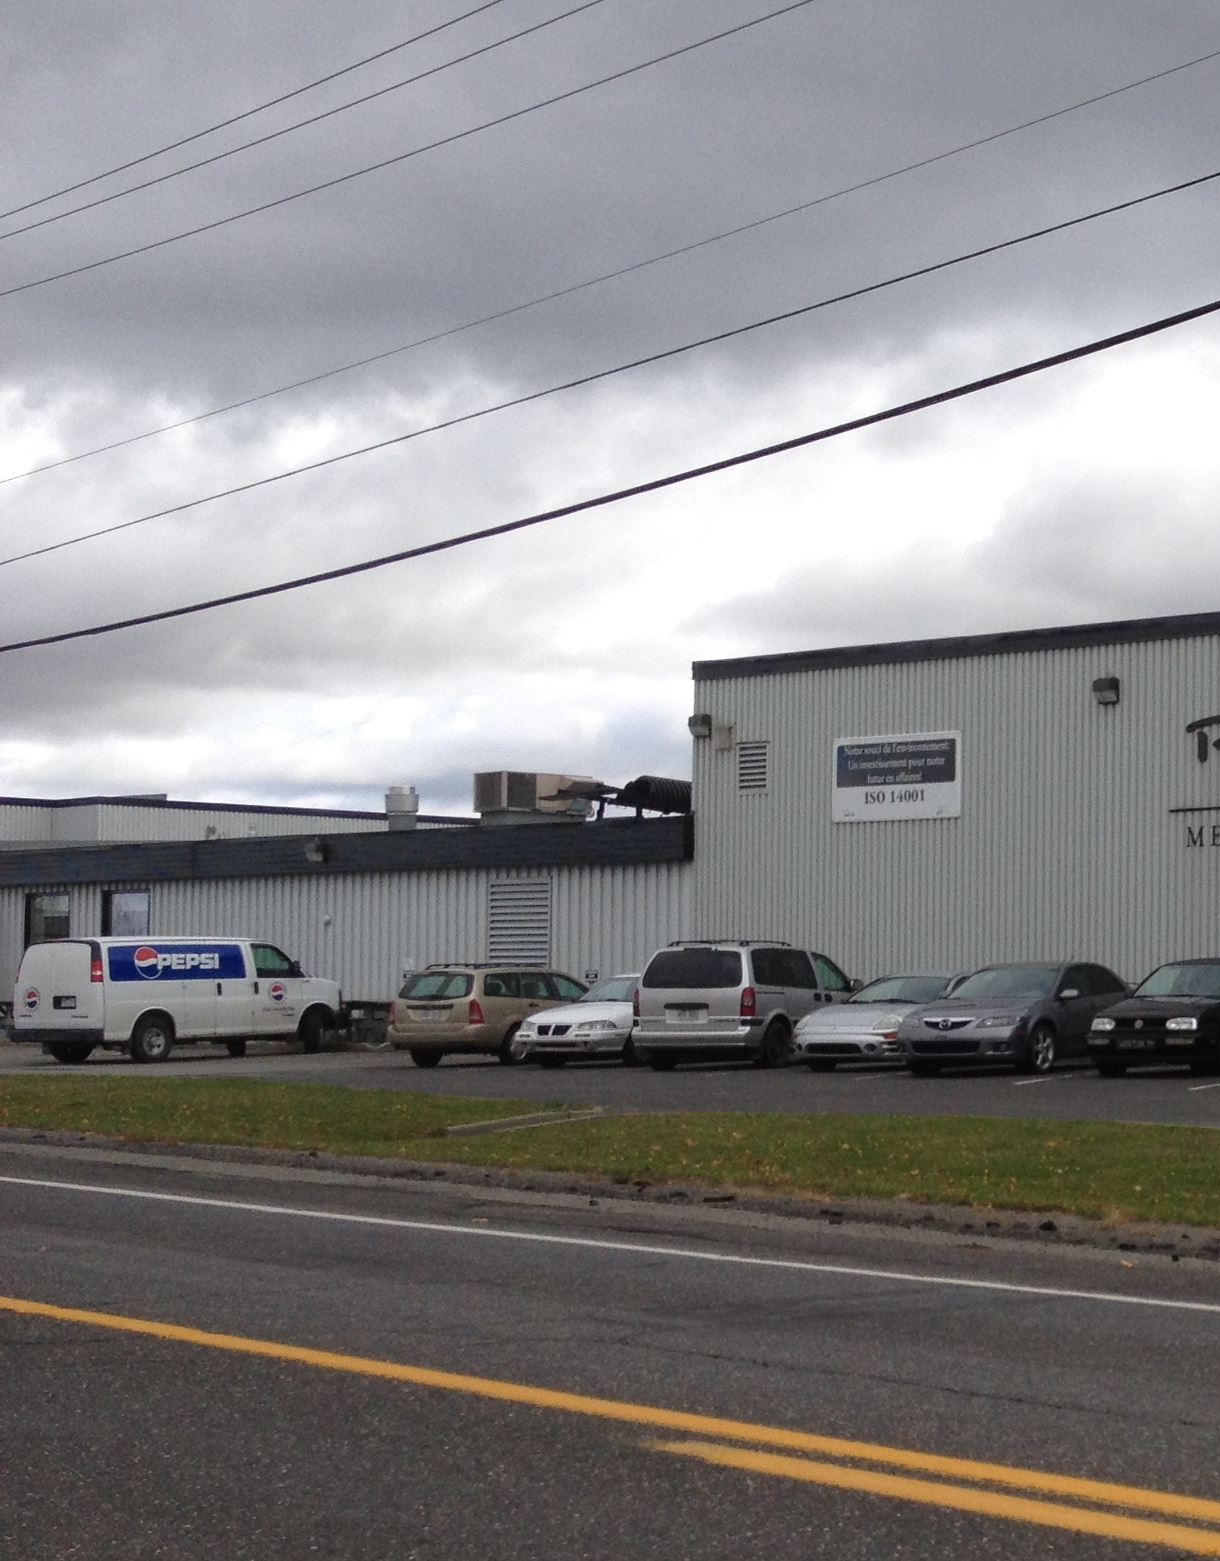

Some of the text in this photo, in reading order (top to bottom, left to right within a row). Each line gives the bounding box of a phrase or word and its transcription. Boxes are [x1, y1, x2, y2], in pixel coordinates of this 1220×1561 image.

[865, 788, 925, 804] ISO 14001
[157, 953, 219, 970] PEPSI
